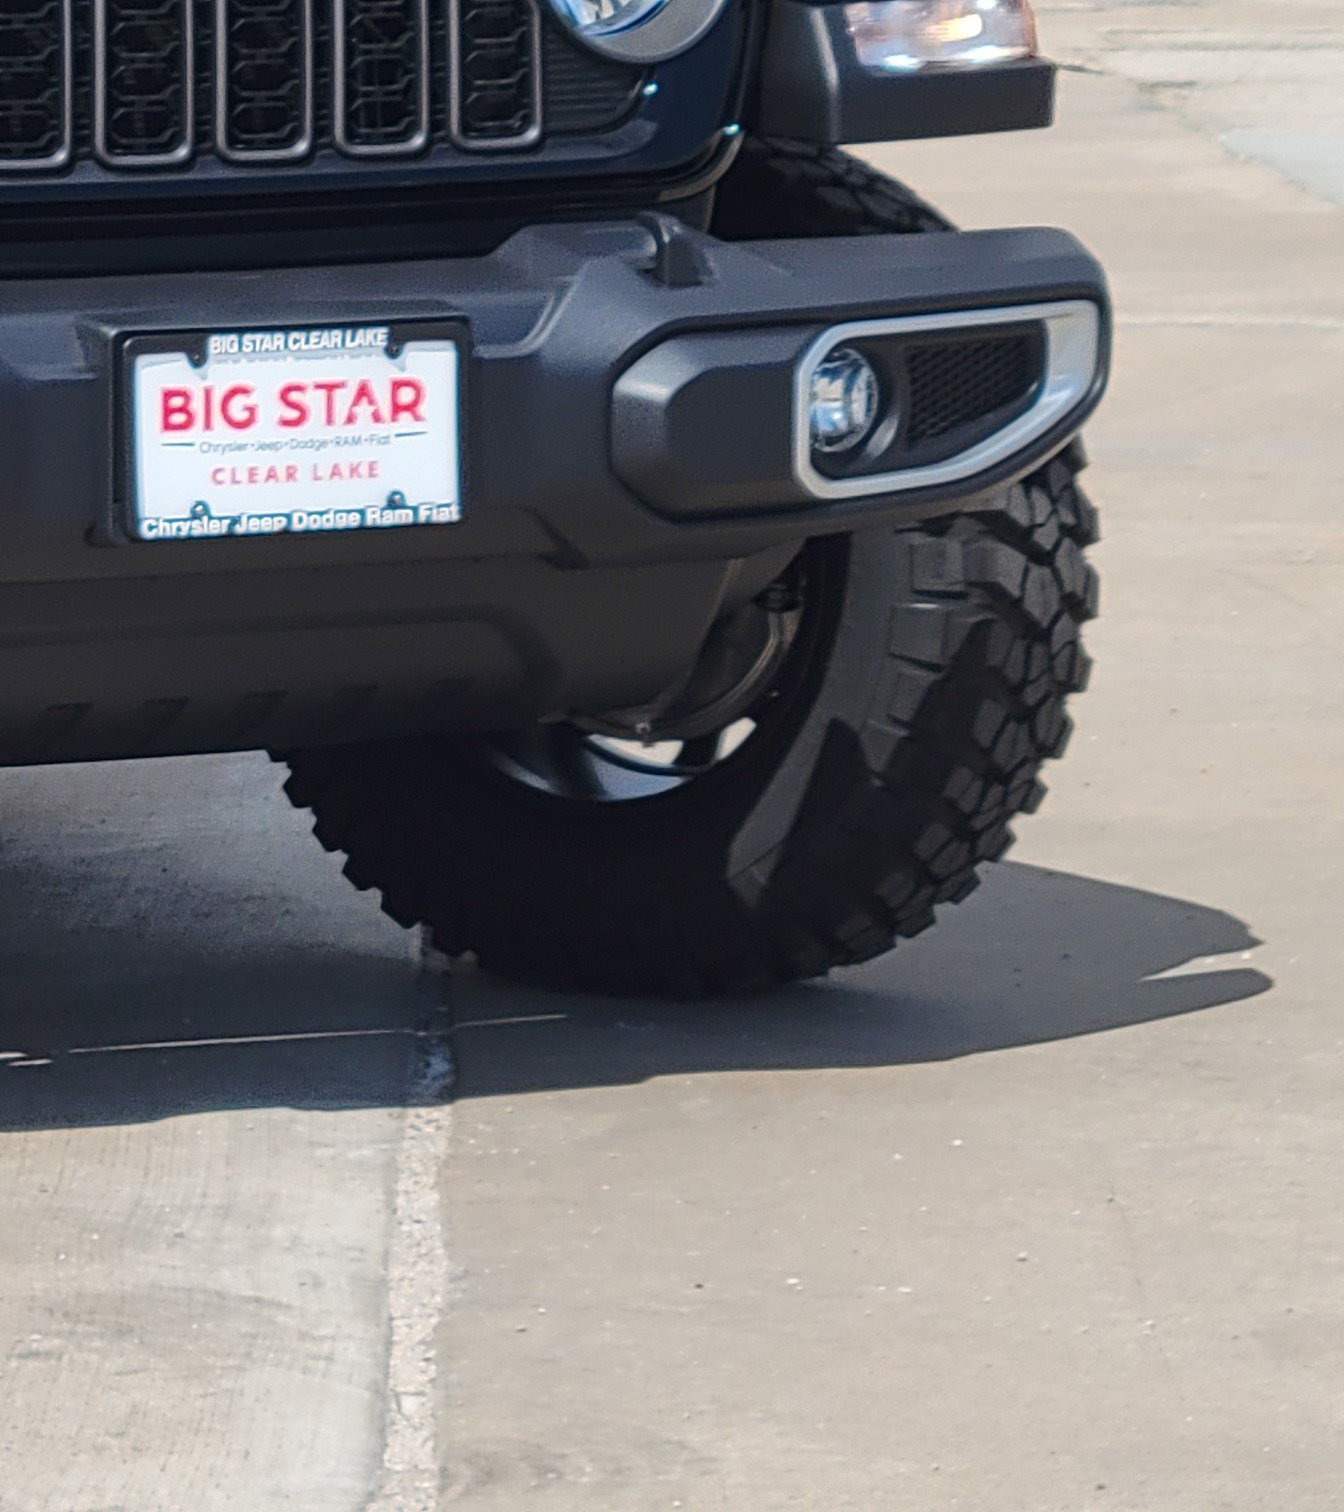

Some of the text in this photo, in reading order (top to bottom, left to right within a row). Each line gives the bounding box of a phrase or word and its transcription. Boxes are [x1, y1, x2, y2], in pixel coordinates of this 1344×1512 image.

[210, 326, 389, 354] BIG STAR CLEAR LAKE
[160, 378, 426, 433] BIG STAR
[211, 460, 380, 486] CLEAR LAKE
[141, 502, 459, 538] Chrysler Jeep Dodge Ram Fiat
